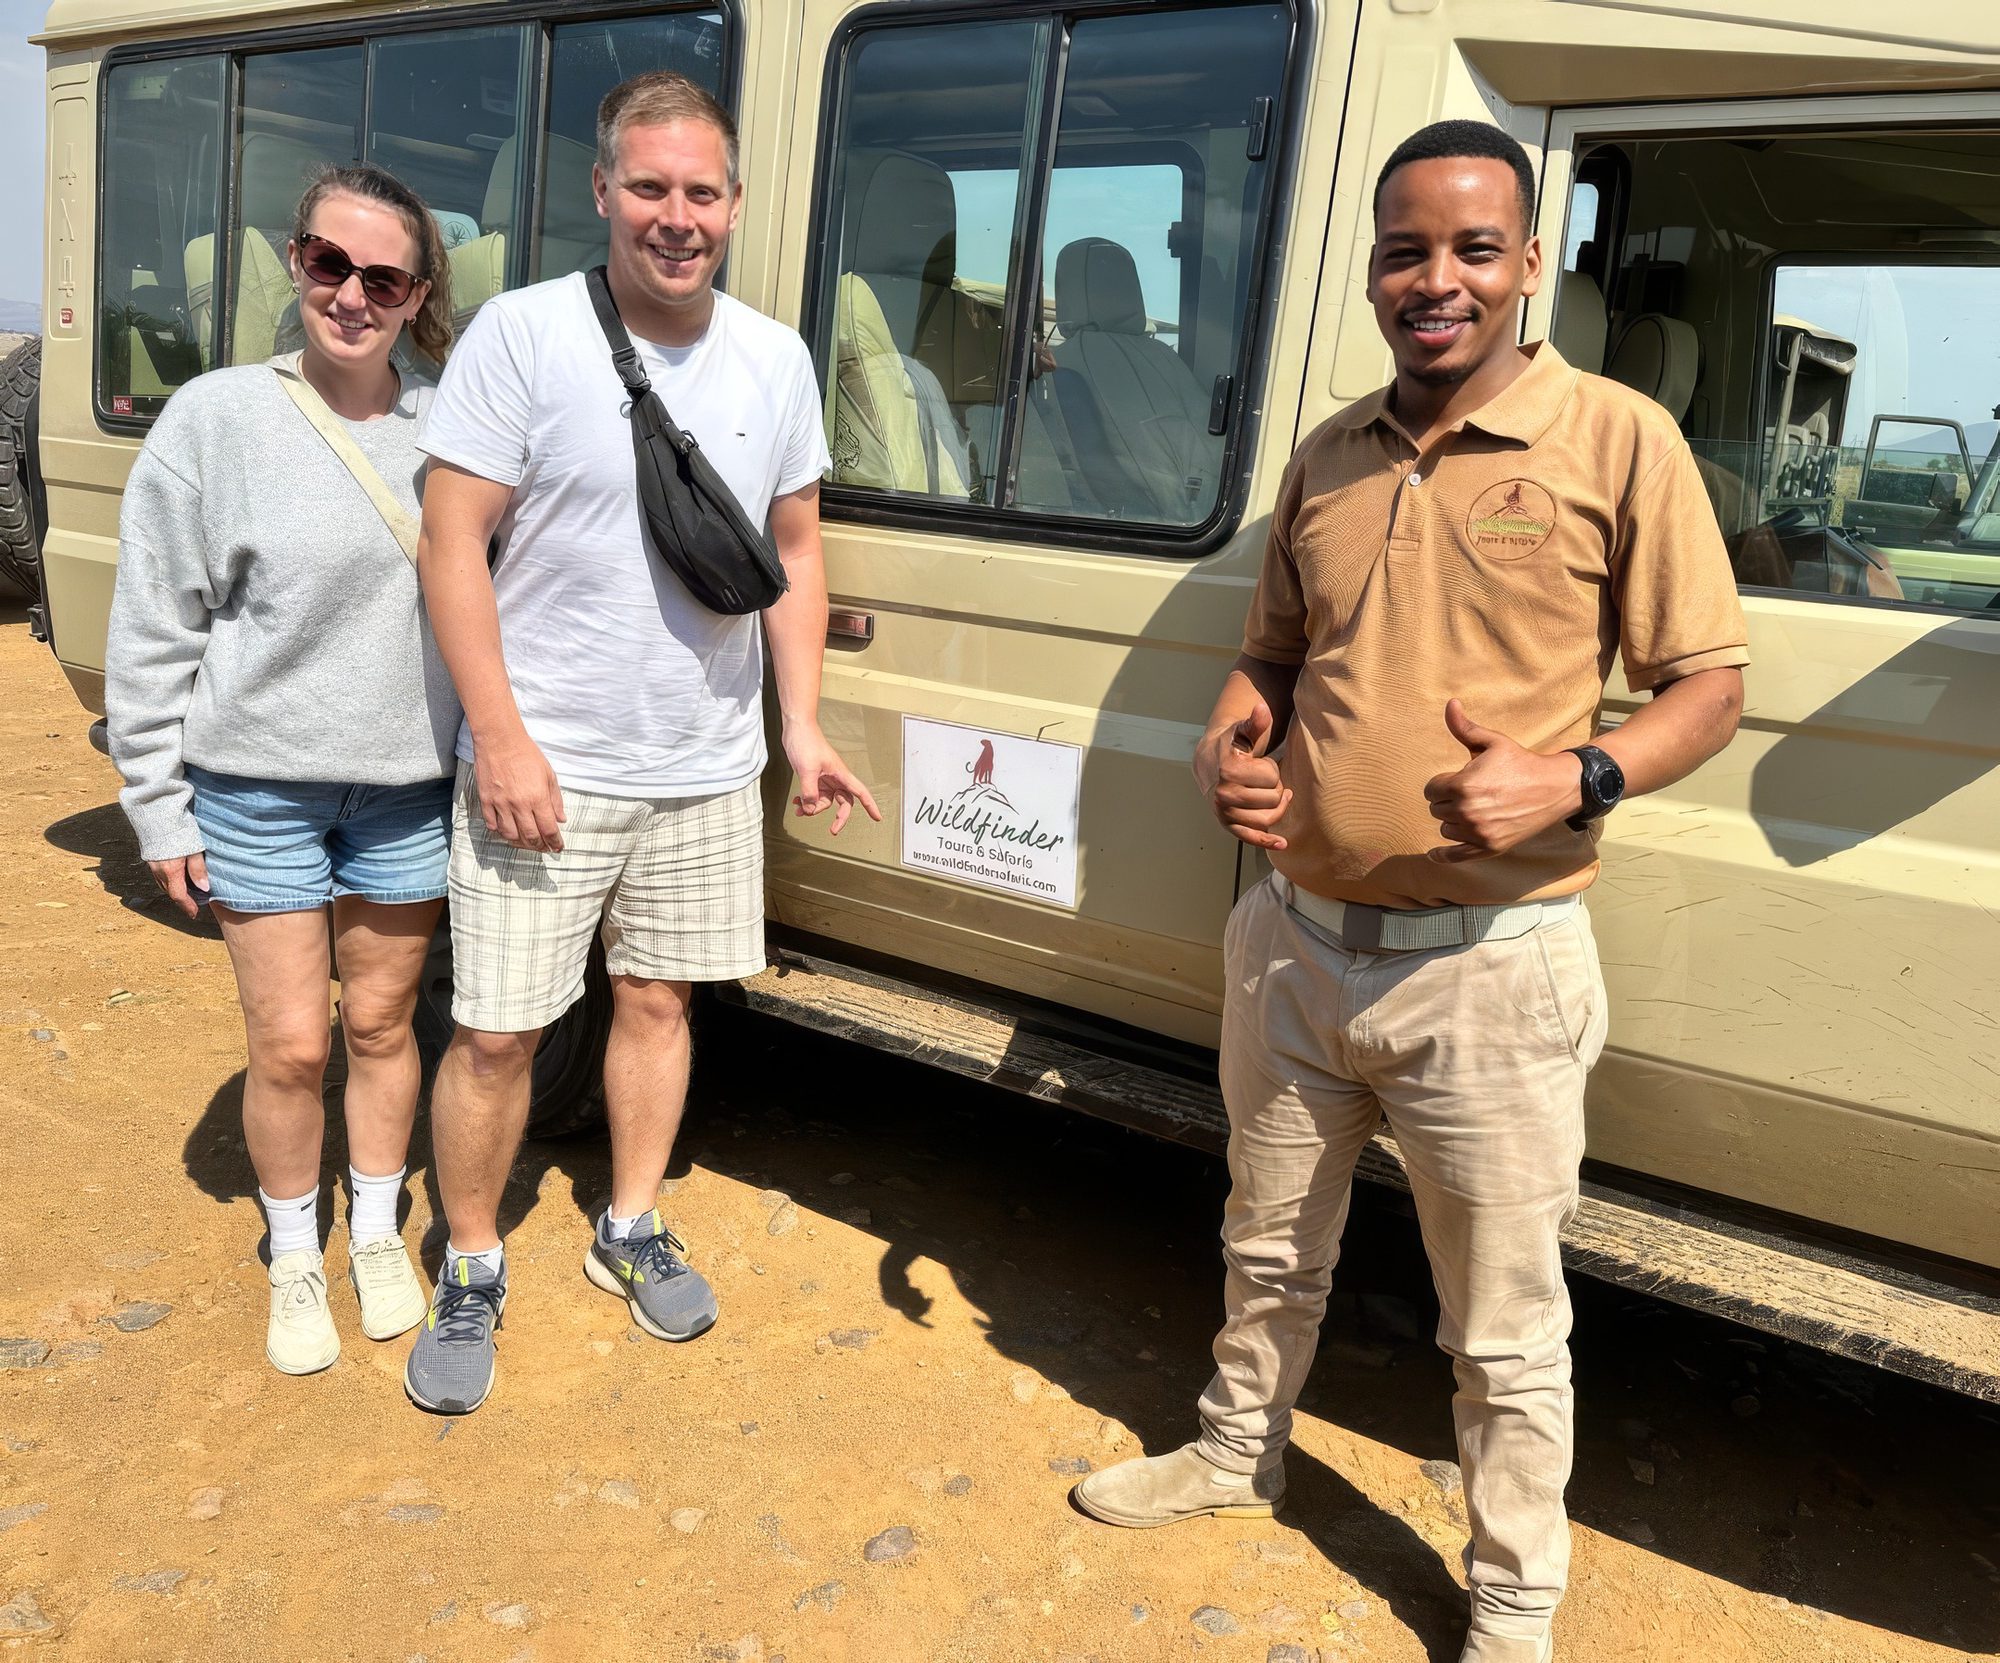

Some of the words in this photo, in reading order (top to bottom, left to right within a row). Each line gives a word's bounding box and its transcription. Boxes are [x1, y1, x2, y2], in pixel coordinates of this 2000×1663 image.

[914, 796, 1064, 852] Wildfinder
[937, 836, 973, 855] Tours
[976, 845, 985, 858] &
[989, 848, 1033, 869] Safaris
